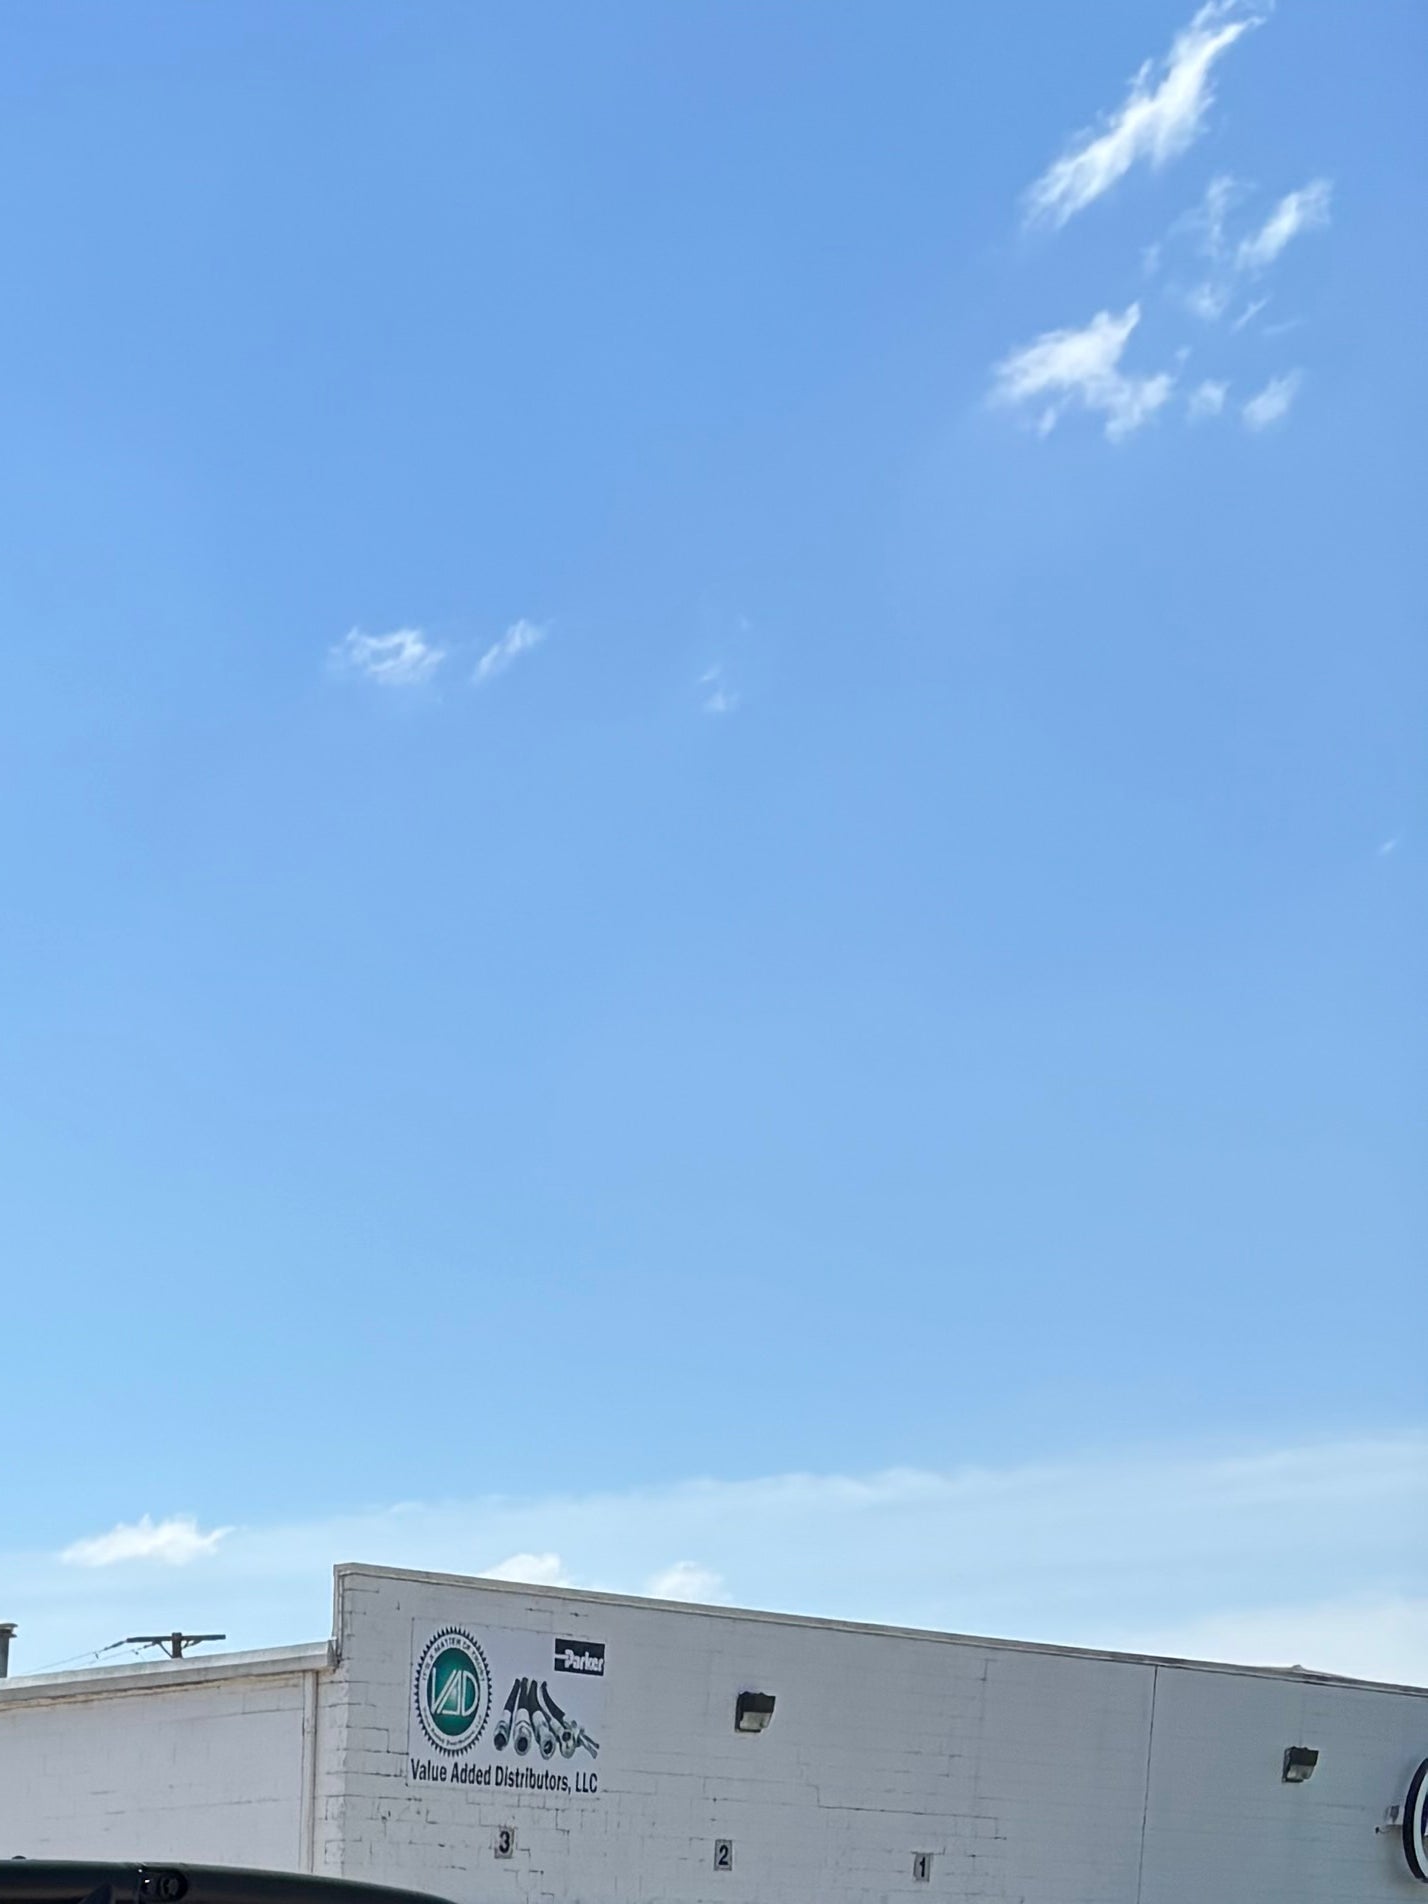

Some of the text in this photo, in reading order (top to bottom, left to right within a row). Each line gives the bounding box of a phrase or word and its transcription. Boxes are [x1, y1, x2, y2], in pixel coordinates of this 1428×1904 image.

[564, 1649, 604, 1673] Parker
[431, 1667, 480, 1717] VAD
[411, 1758, 599, 1796] Value Added Distributors, LLC
[499, 1831, 511, 1854] 3
[718, 1844, 729, 1866] 2
[919, 1857, 926, 1878] 1
